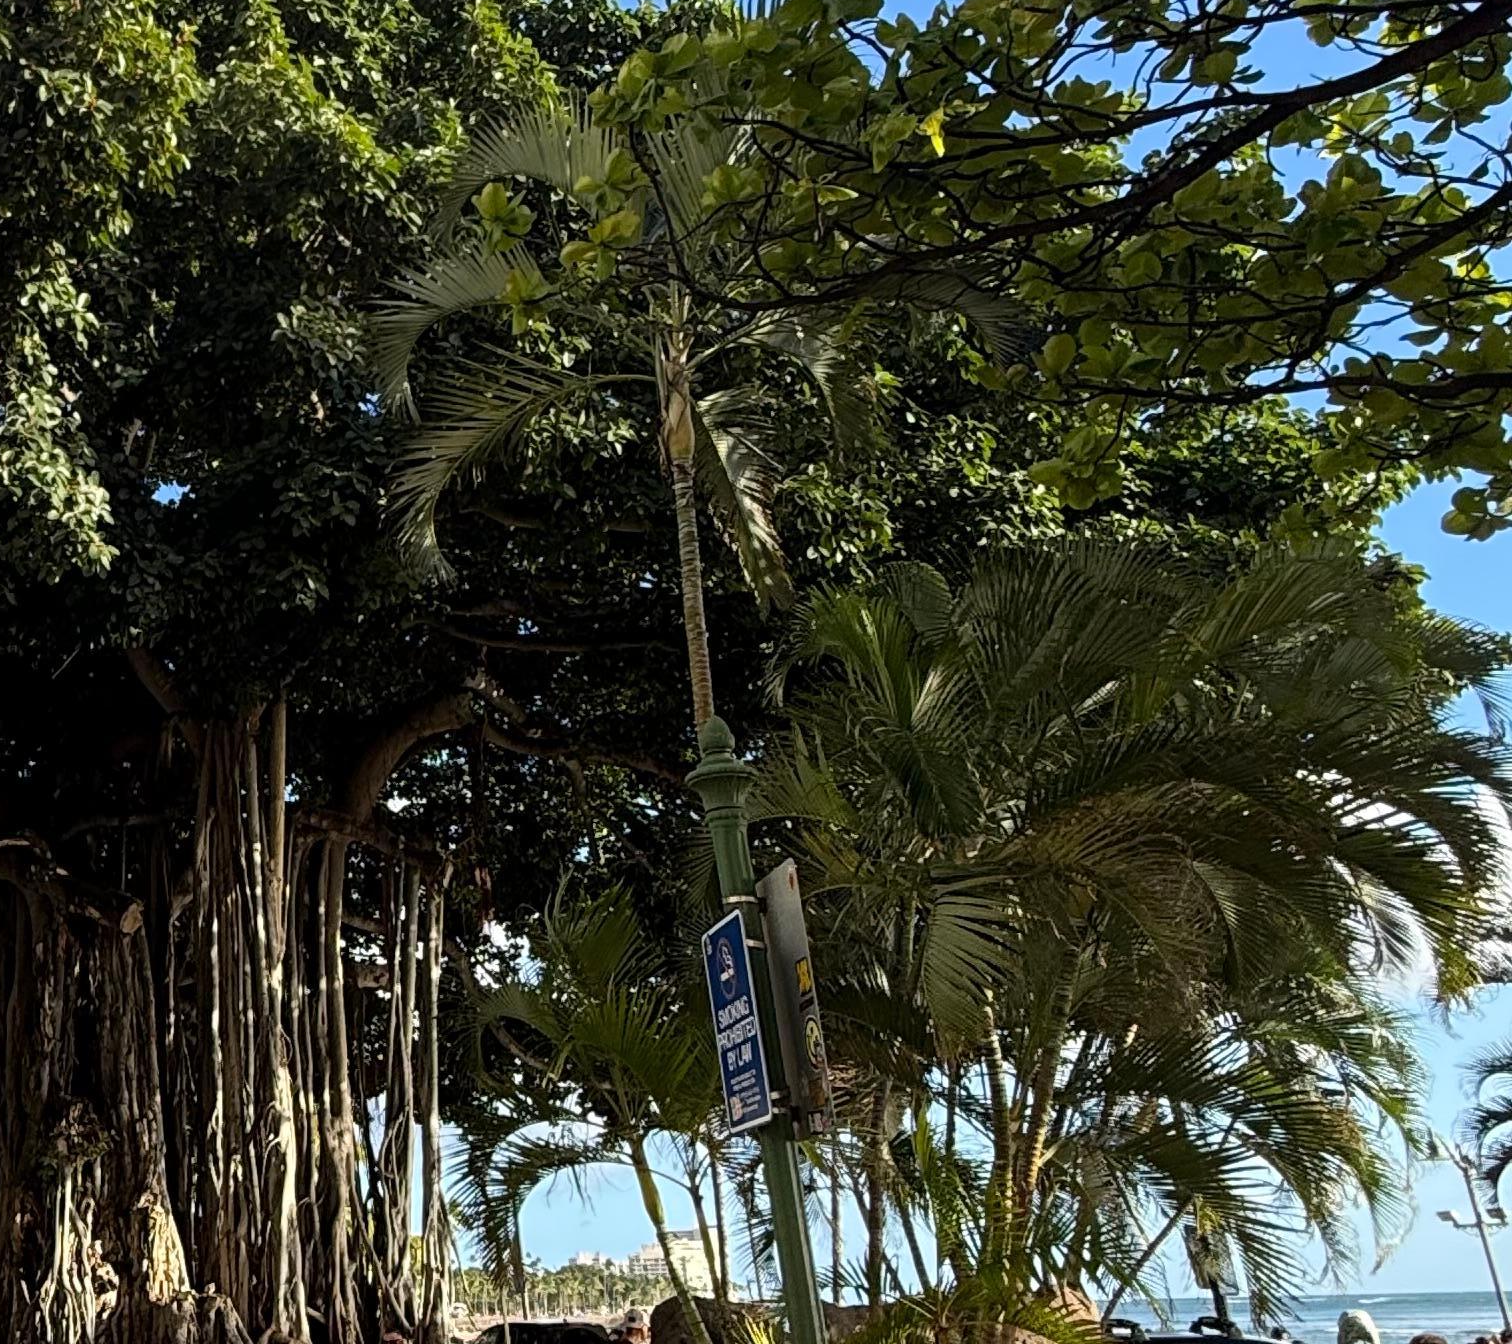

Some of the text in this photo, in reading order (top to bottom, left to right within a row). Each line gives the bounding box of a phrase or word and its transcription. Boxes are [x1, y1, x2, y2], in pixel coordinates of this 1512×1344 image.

[717, 995, 750, 1029] SMOKING
[718, 1016, 756, 1051] PROHIBITED
[727, 1041, 752, 1071] BY LAW
